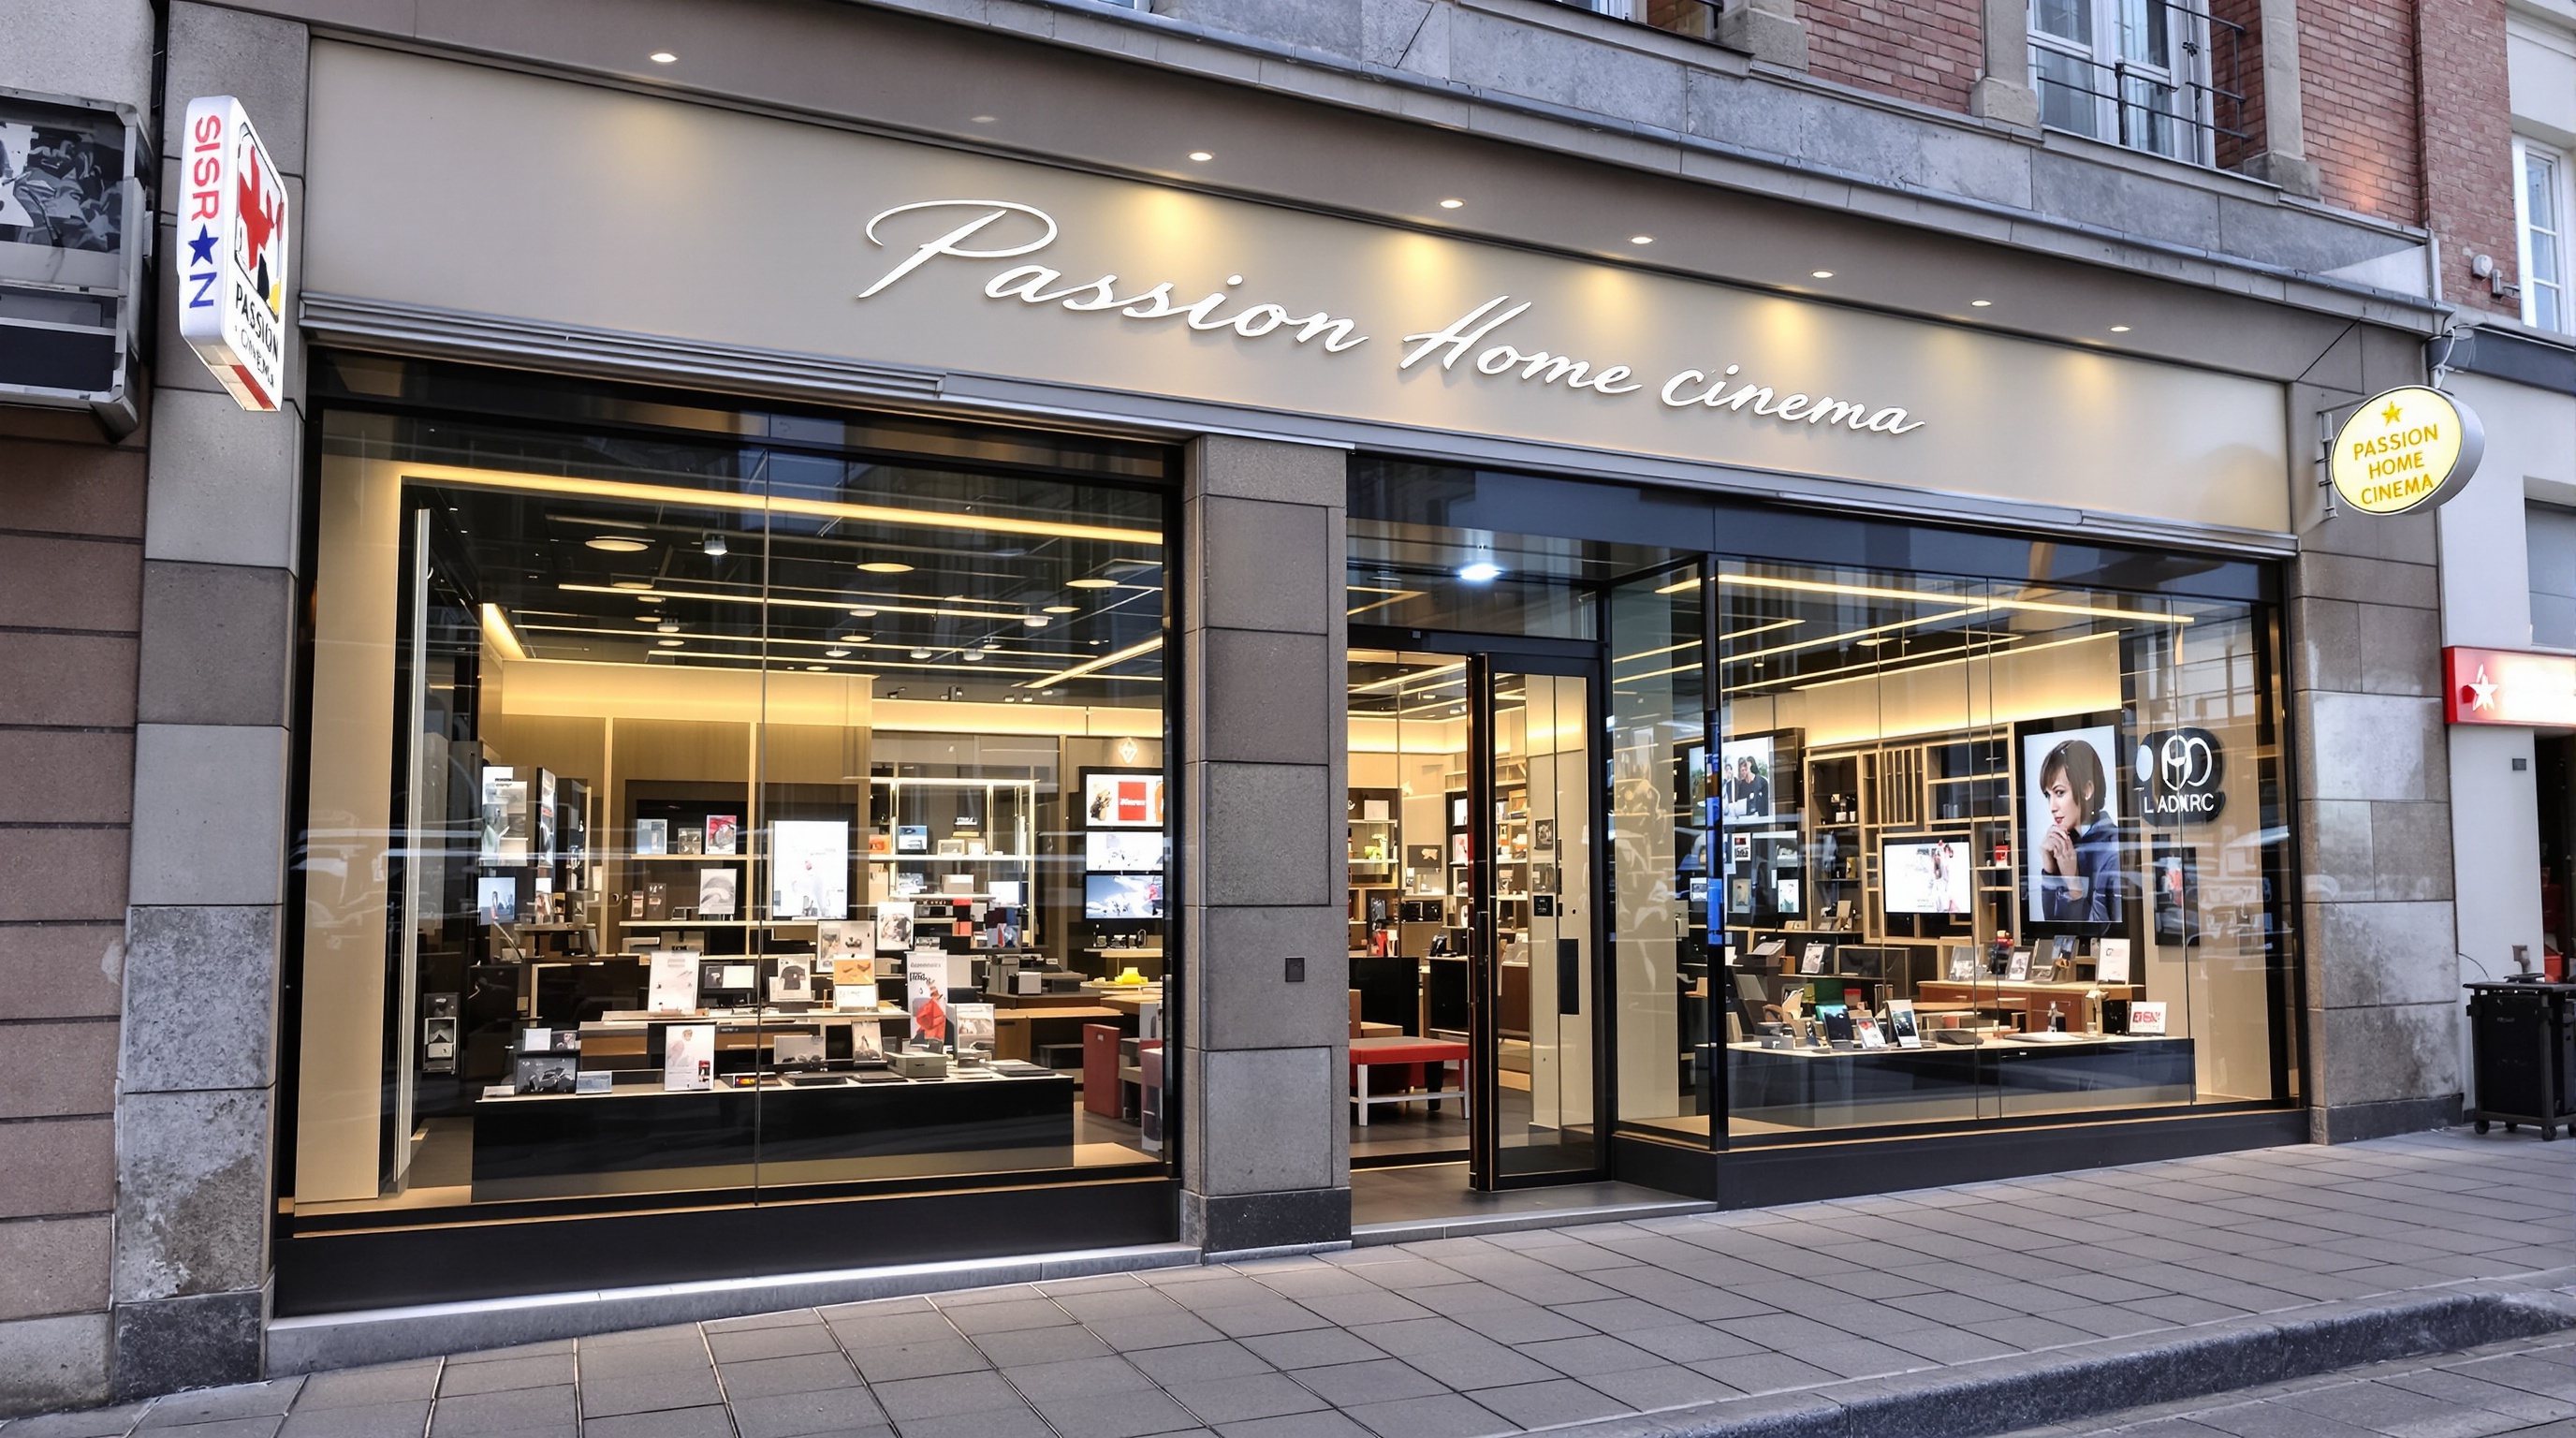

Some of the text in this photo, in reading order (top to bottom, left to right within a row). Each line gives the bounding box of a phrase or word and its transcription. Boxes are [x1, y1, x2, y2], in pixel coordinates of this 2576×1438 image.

[235, 280, 279, 363] PASSION
[856, 198, 1926, 435] Passion Home cinema
[2353, 423, 2438, 462] PASSION
[2368, 450, 2425, 479] HOME
[2361, 473, 2434, 505] CINEMA
